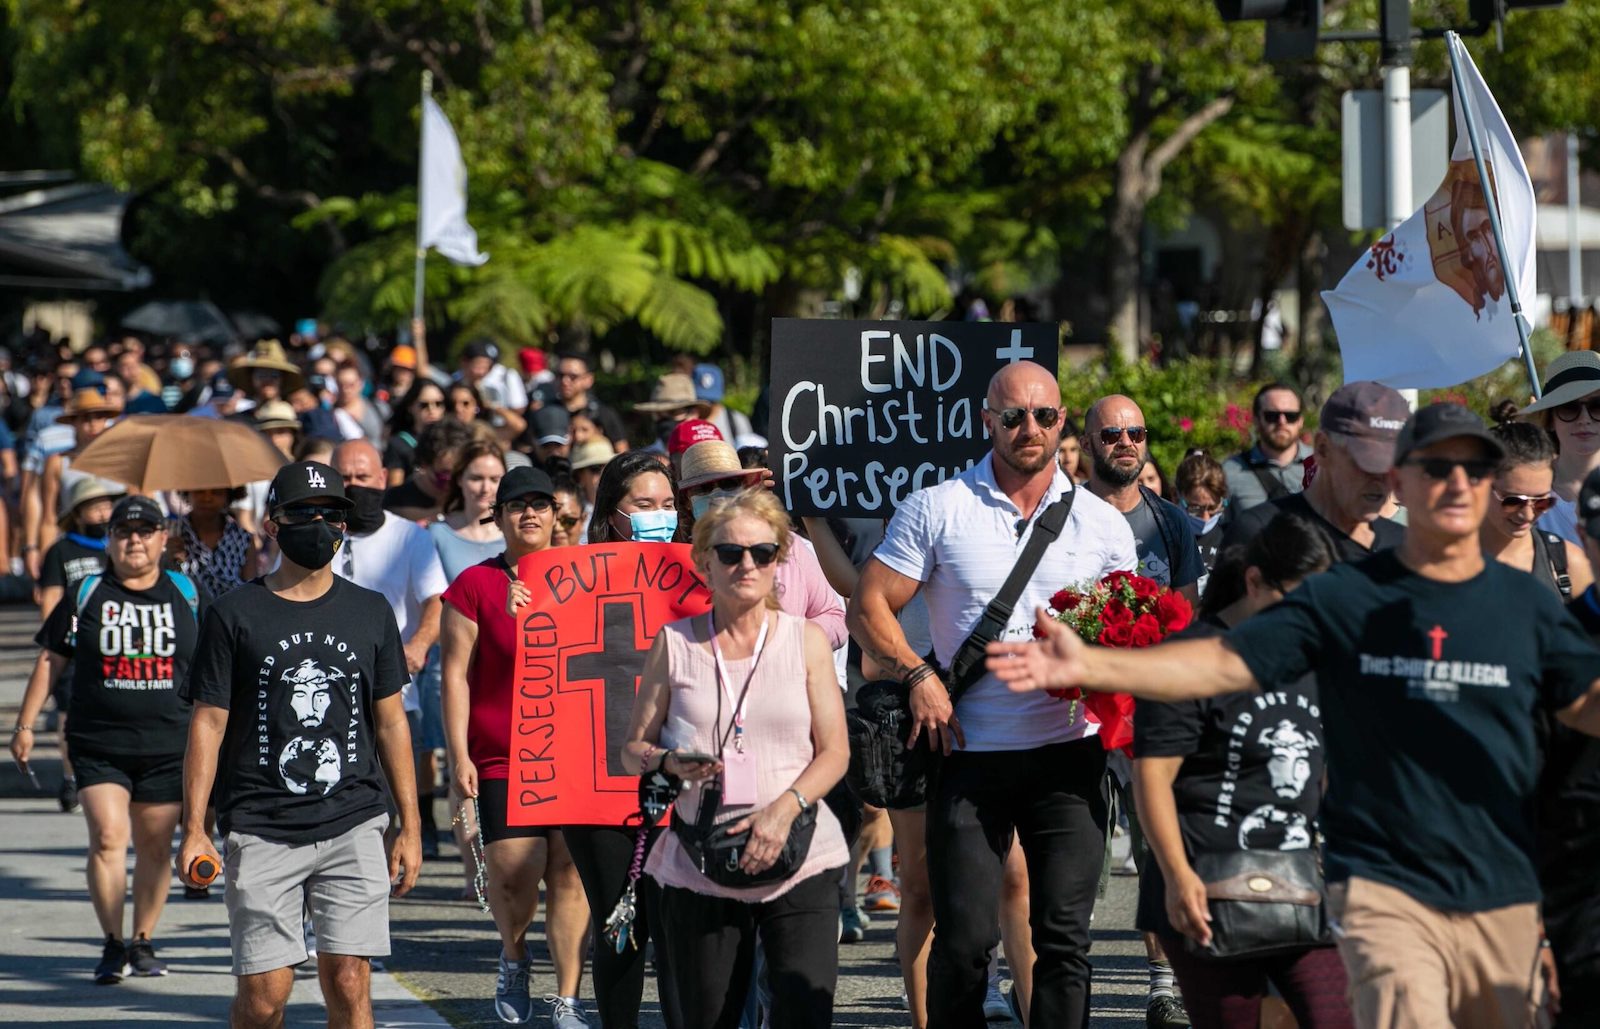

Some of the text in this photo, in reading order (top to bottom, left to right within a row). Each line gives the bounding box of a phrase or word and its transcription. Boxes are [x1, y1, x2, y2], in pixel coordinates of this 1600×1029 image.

[860, 330, 962, 393] END
[306, 466, 326, 488] LA
[782, 451, 975, 511] Persec
[100, 626, 176, 656] OLIC
[101, 600, 175, 628] CATH
[102, 656, 174, 679] FAITH
[519, 552, 707, 807] PERSECUTED BUT NOT
[258, 655, 275, 766] PERSECUTED
[279, 632, 313, 651] BUT
[324, 634, 357, 662] NOT
[1214, 692, 1321, 828] PERSECUTED BUT NO
